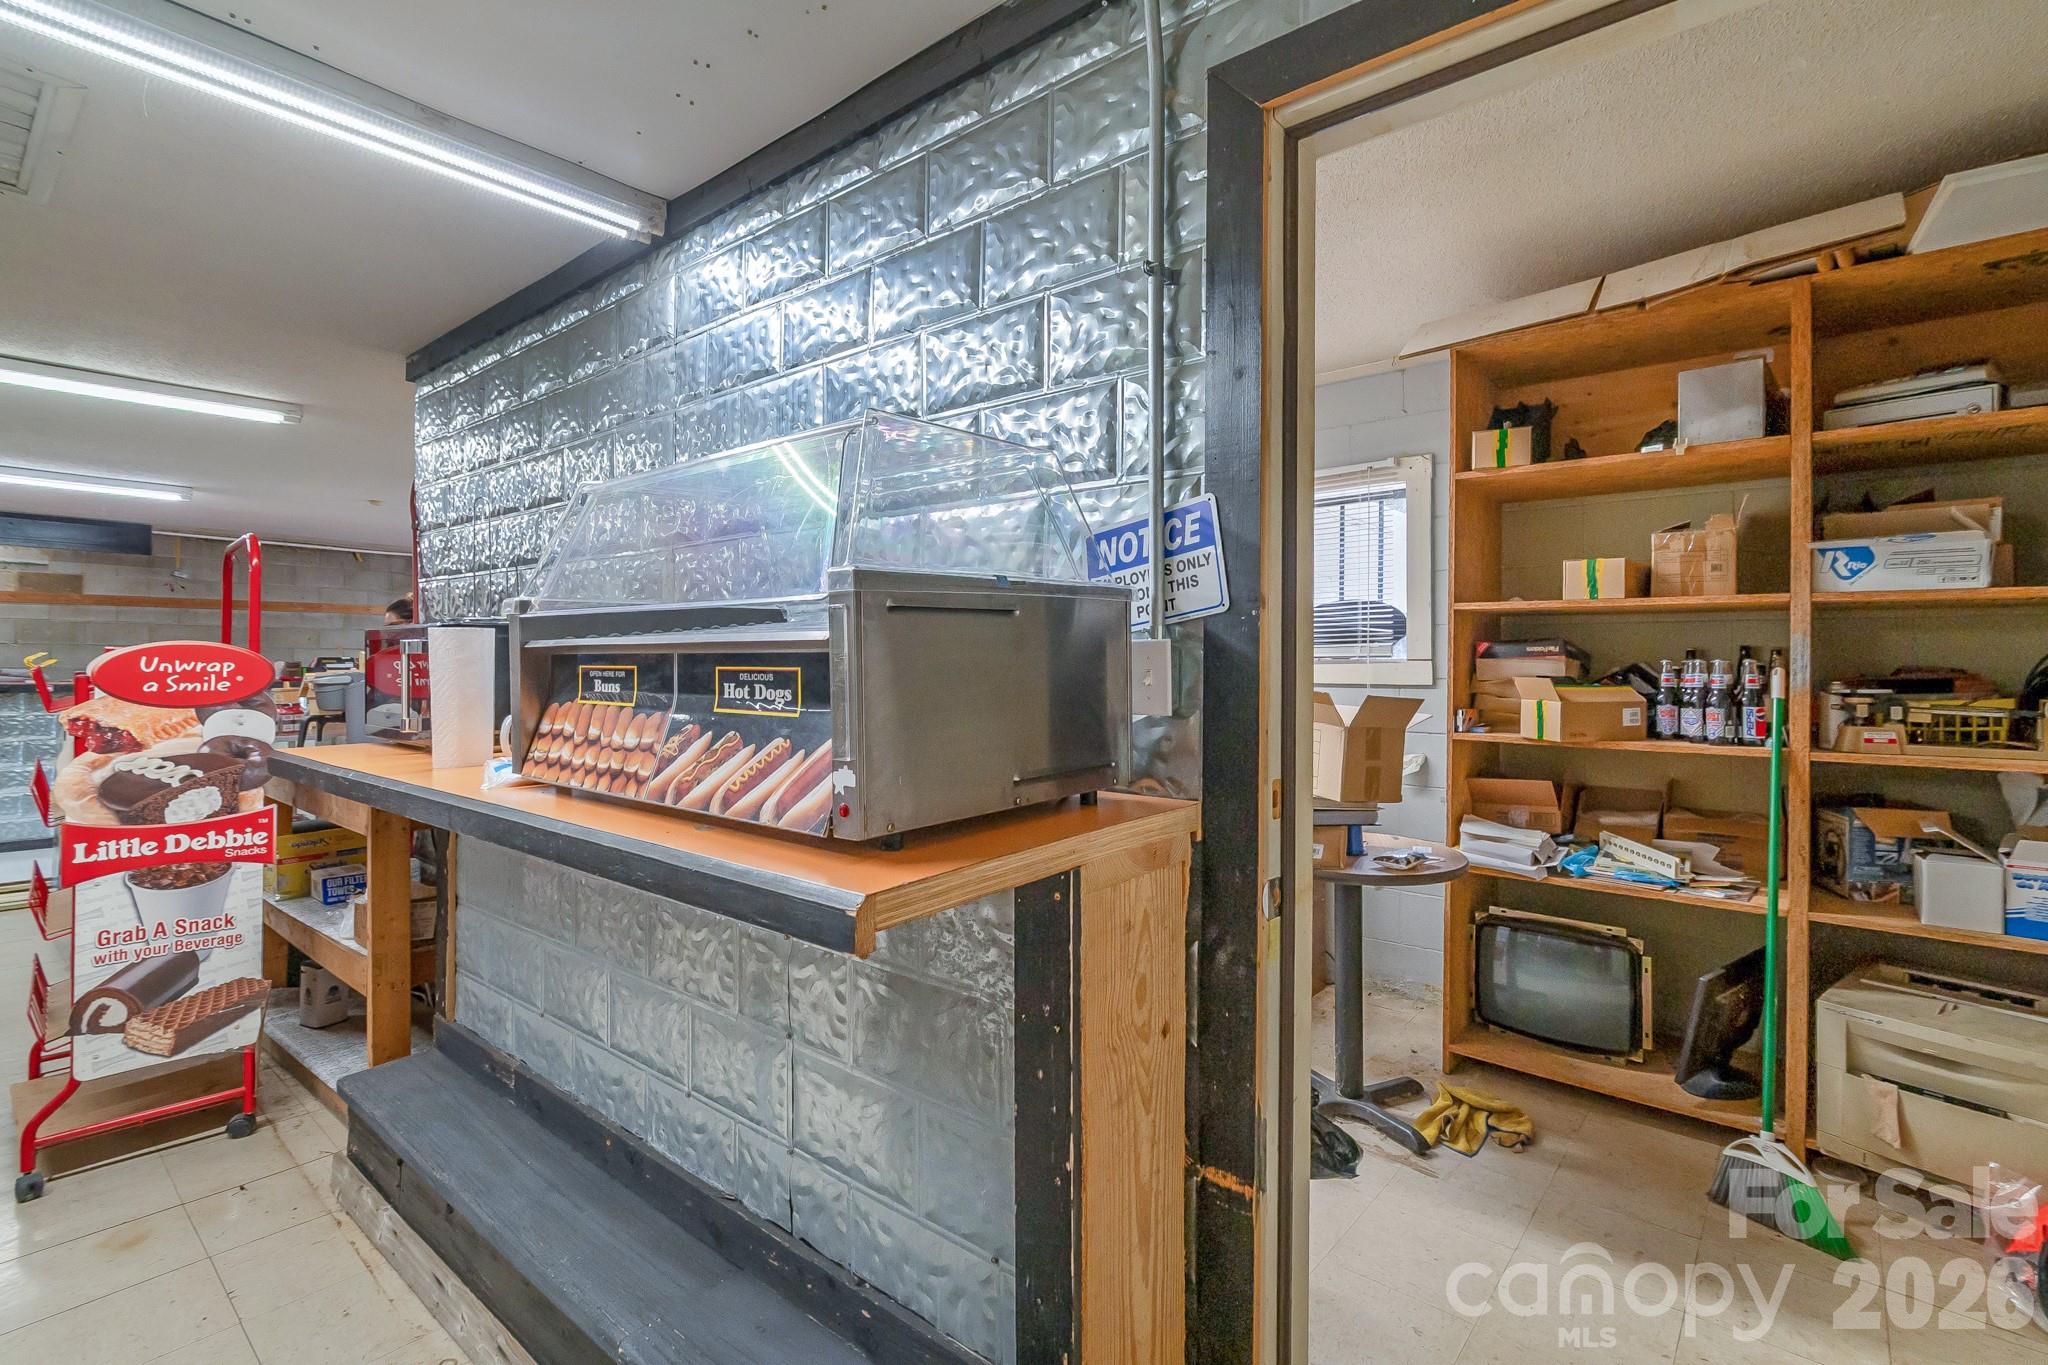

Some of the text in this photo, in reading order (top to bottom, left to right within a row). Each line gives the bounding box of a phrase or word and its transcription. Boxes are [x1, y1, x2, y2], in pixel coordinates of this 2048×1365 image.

[1098, 511, 1200, 570] NOTCE
[1177, 552, 1212, 573] ONLY
[1168, 575, 1199, 593] THIS
[140, 656, 235, 677] Unwrap
[739, 673, 774, 681] DELICIOUS
[143, 675, 231, 692] a Smile
[593, 679, 621, 693] Buns
[723, 683, 792, 706] Hot Dogs
[72, 828, 269, 864] Little Debbie
[224, 846, 268, 857] Snacks
[97, 913, 236, 947] Grab A Snack
[93, 933, 242, 965] with your Beverage
